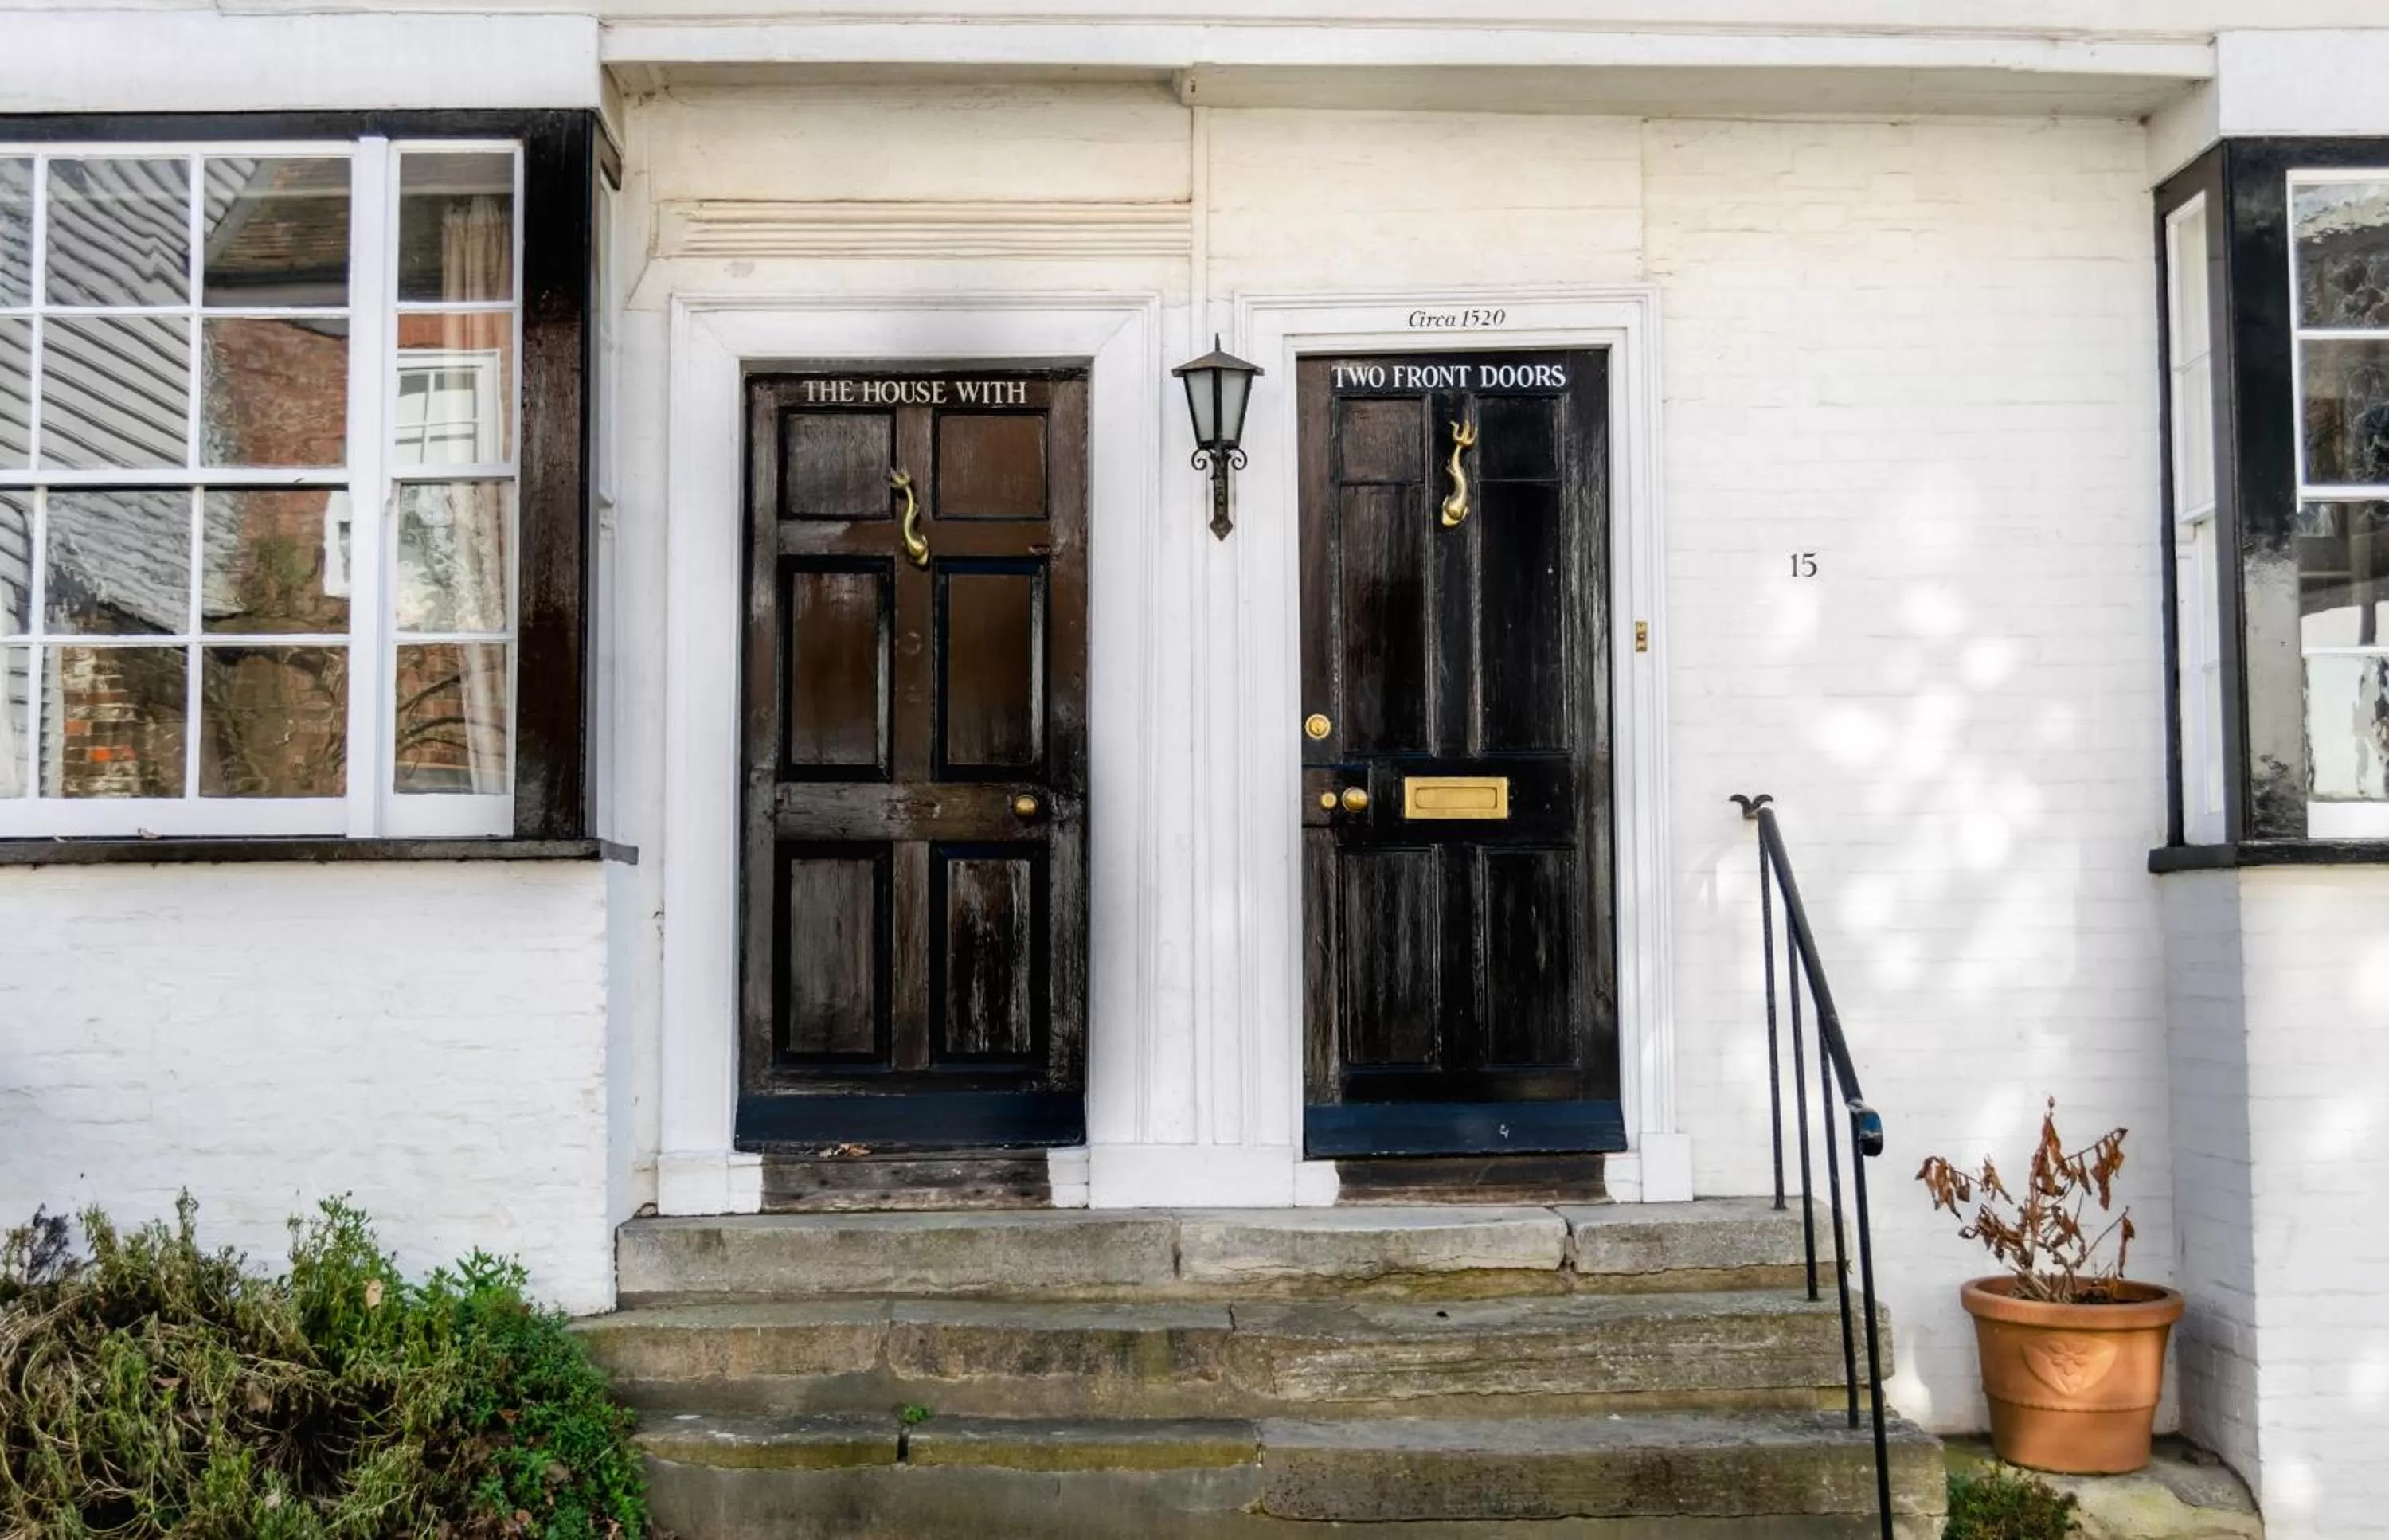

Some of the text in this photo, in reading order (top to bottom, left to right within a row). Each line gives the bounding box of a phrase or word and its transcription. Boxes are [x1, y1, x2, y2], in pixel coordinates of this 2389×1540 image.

[1408, 308, 1506, 327] Circa 1520
[1332, 365, 1566, 388] TWO FRONT DOORS
[803, 380, 1027, 404] THE HOUSE WITH
[1790, 553, 1817, 577] 15
